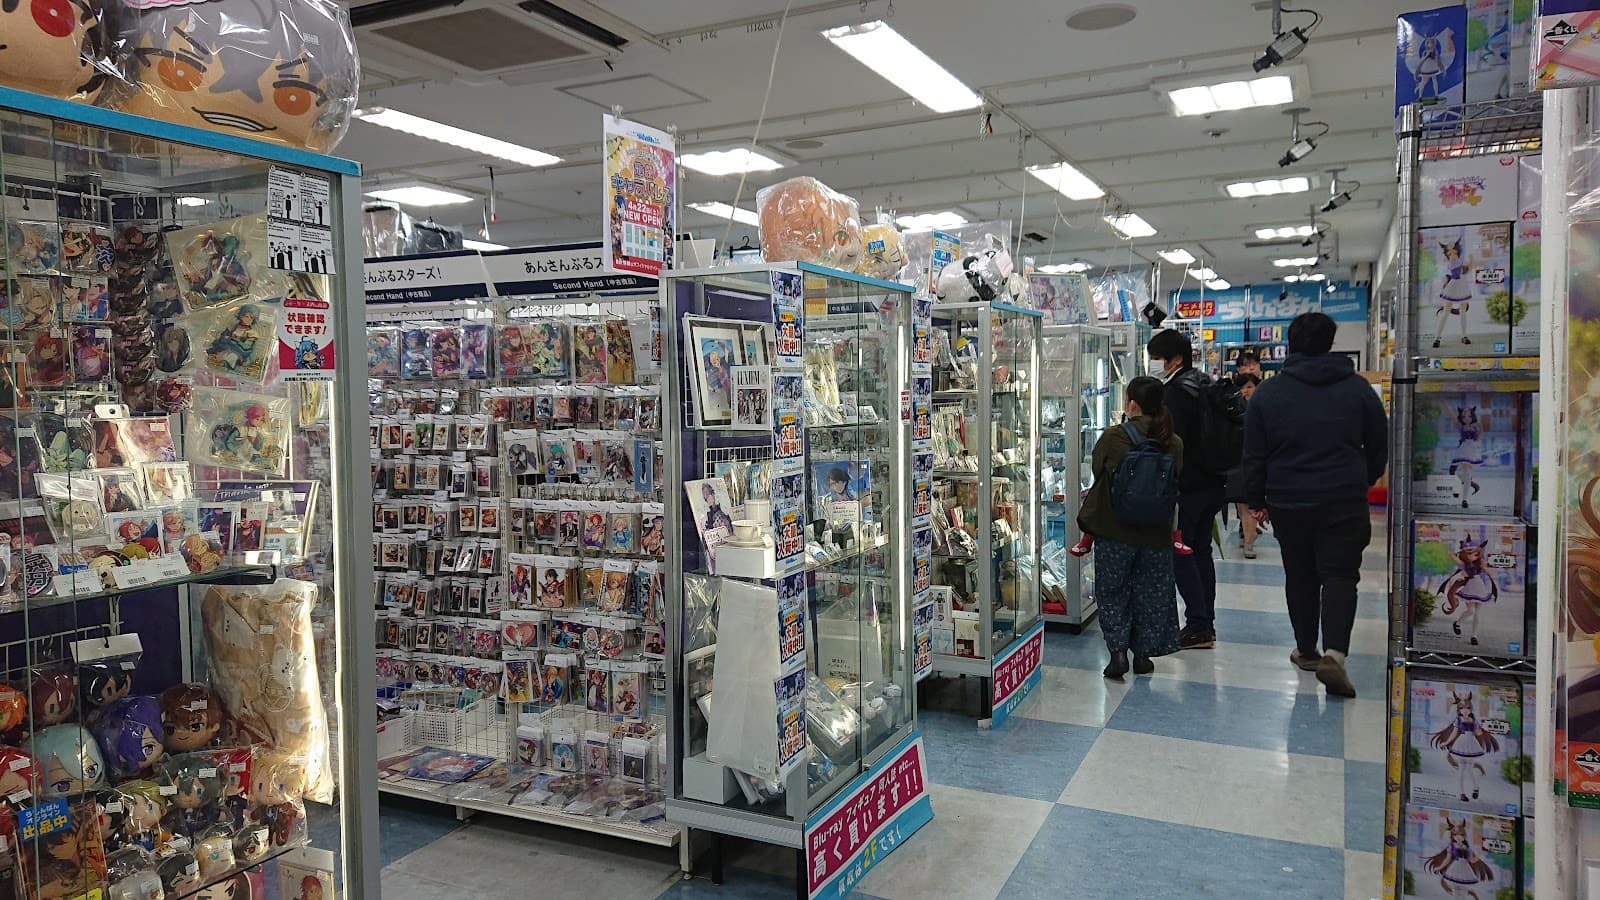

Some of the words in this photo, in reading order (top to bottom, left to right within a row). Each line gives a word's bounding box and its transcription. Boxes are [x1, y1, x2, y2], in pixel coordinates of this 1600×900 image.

[624, 210, 641, 221] NEW
[642, 214, 663, 227] OPEN!
[553, 281, 581, 290] Second
[583, 278, 604, 288] Hand
[365, 293, 385, 301] econd
[386, 291, 404, 300] Hand
[284, 324, 327, 335] できます!
[813, 815, 843, 851] Blu-ray
[846, 786, 876, 823] フィギュア
[813, 768, 919, 884] 高く買います!!
